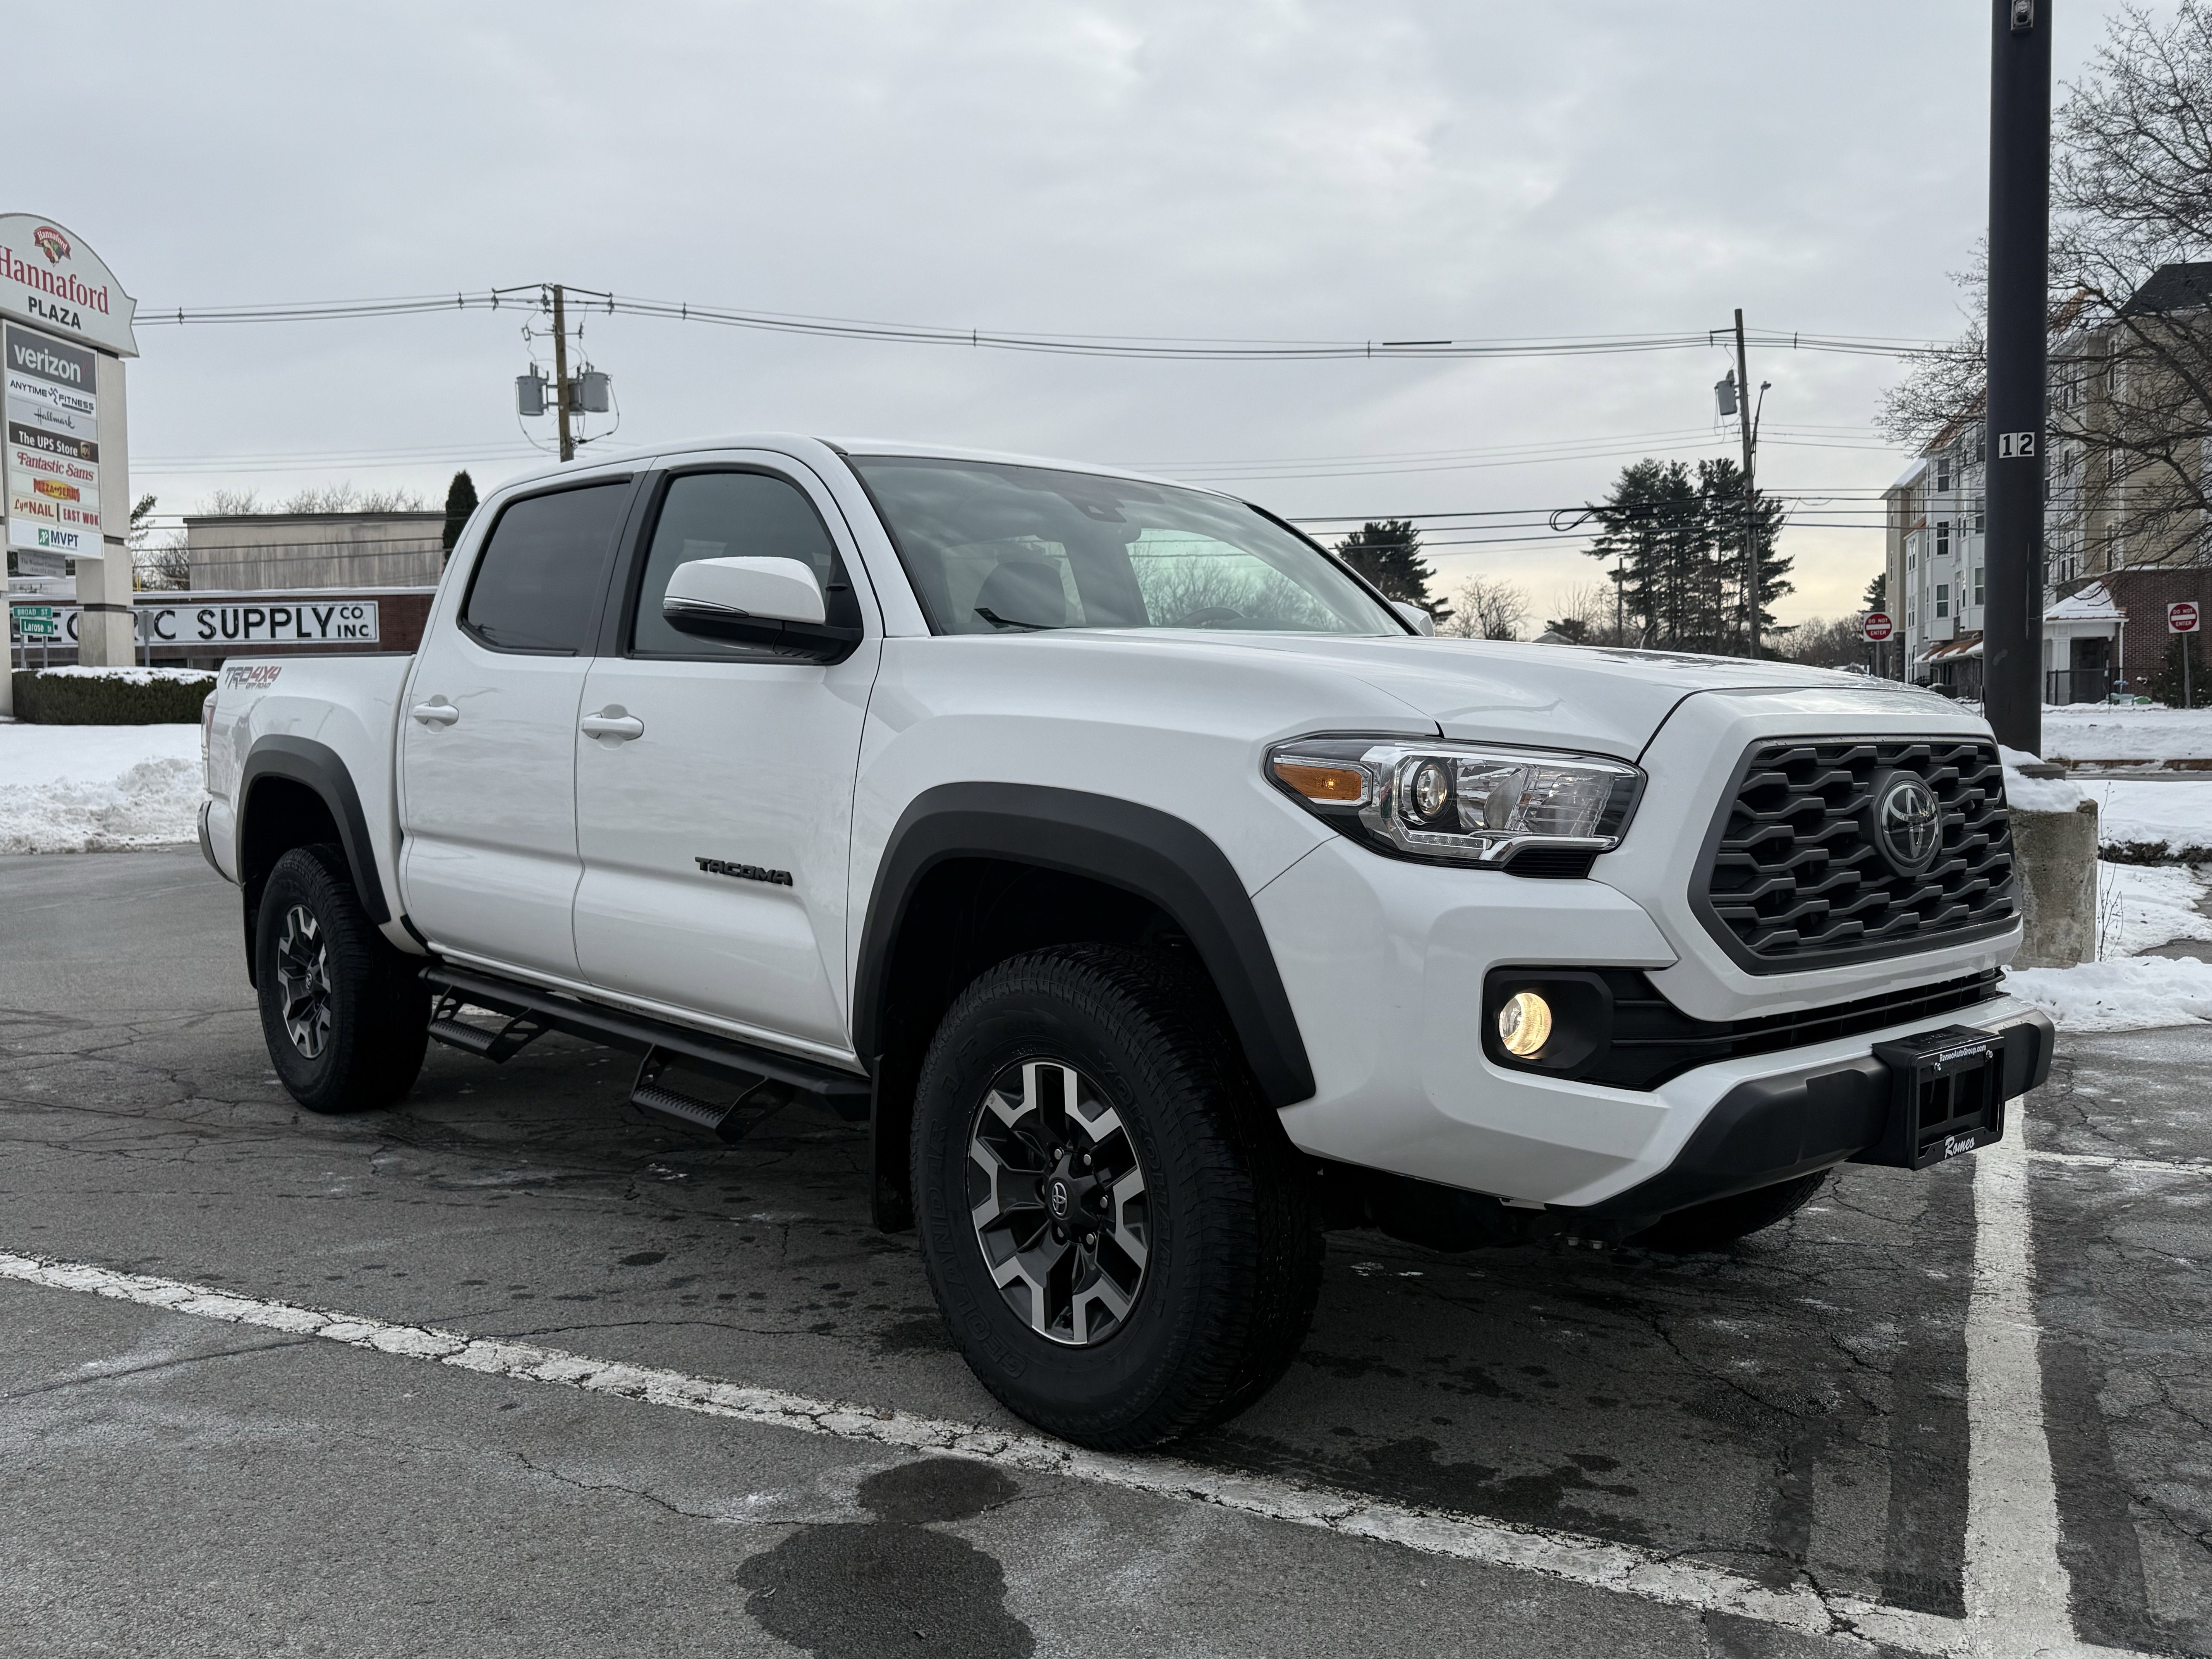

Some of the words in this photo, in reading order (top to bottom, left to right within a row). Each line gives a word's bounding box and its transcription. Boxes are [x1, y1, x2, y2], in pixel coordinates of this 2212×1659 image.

[38, 231, 67, 250] Hannaford
[0, 245, 109, 315] Hannaford
[28, 295, 81, 330] PLAZA
[14, 344, 81, 383] verizon
[10, 380, 47, 397] ANYTIME
[59, 394, 94, 410] FITNESS
[34, 406, 75, 429] Hallmark
[19, 431, 35, 446] The
[37, 435, 54, 450] UPS
[57, 441, 78, 457] Store
[2003, 434, 2032, 456] 12
[17, 452, 64, 474] Fantastic
[66, 463, 94, 481] Sams
[29, 501, 54, 517] NAIL
[63, 508, 80, 522] EAST
[82, 512, 99, 526] WOK
[51, 531, 79, 547] MVPT
[24, 621, 44, 632] Larose
[198, 606, 335, 640] SUPPLY
[695, 856, 793, 886] TACOMA
[1939, 1044, 1986, 1062] RomeoAutoGroup.com
[1944, 1136, 1975, 1159] Romeo
[1099, 1049, 1170, 1319] YOKOHAMA
